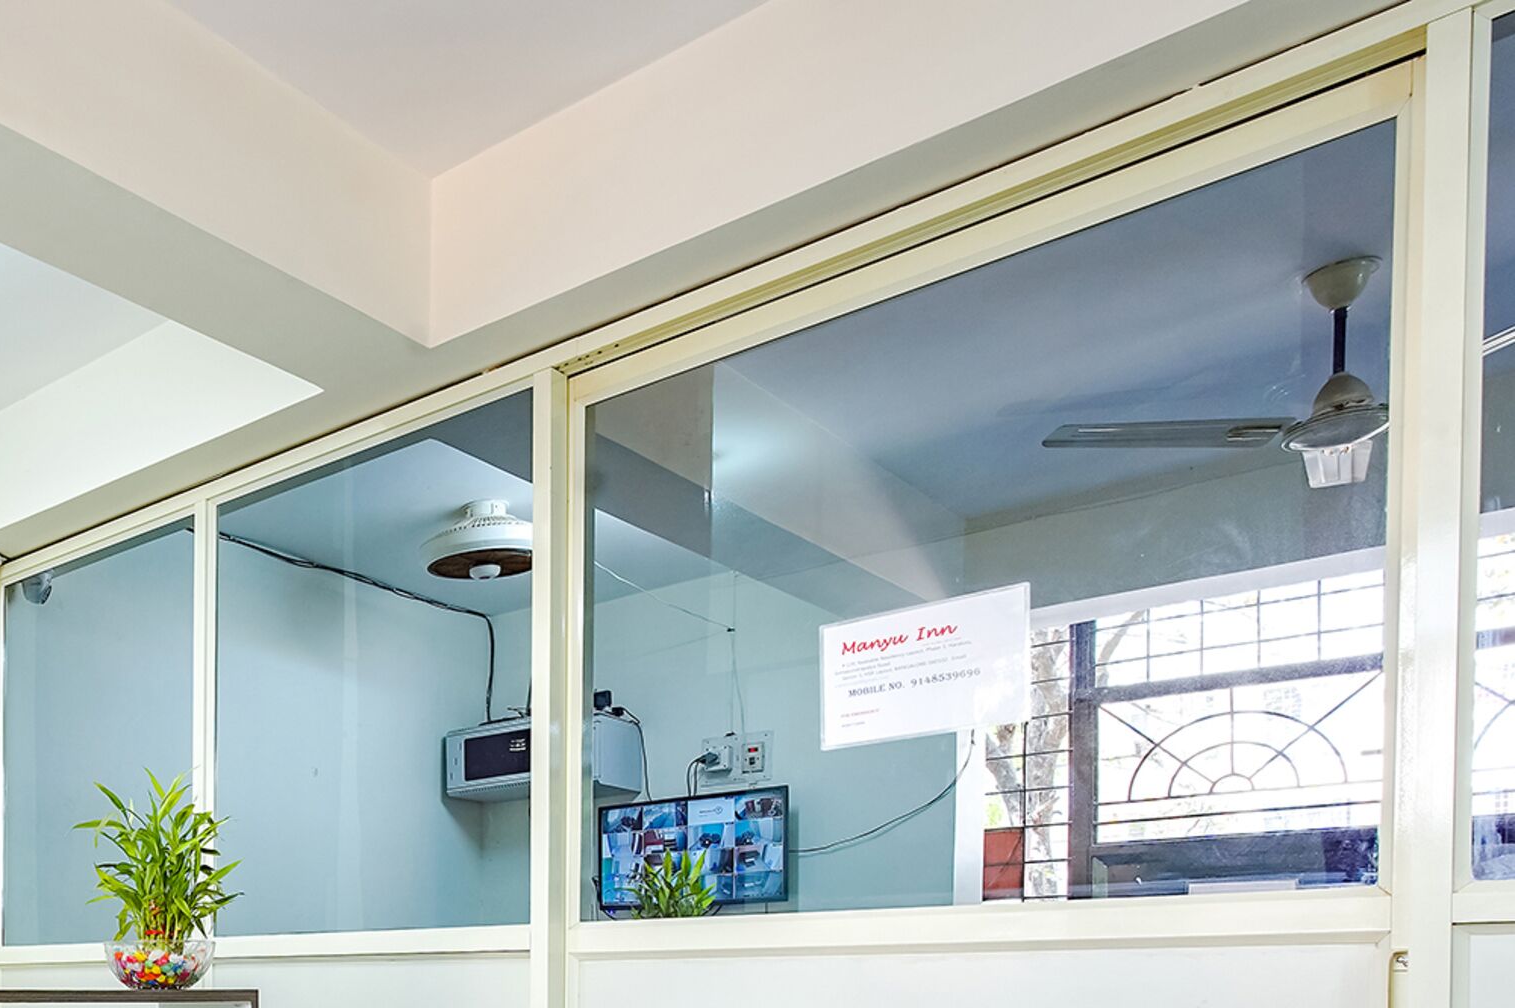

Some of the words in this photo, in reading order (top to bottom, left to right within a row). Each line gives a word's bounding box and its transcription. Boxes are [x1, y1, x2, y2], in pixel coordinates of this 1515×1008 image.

[841, 634, 908, 655] Manyu
[916, 624, 958, 642] Inn
[847, 681, 887, 698] MOBILE
